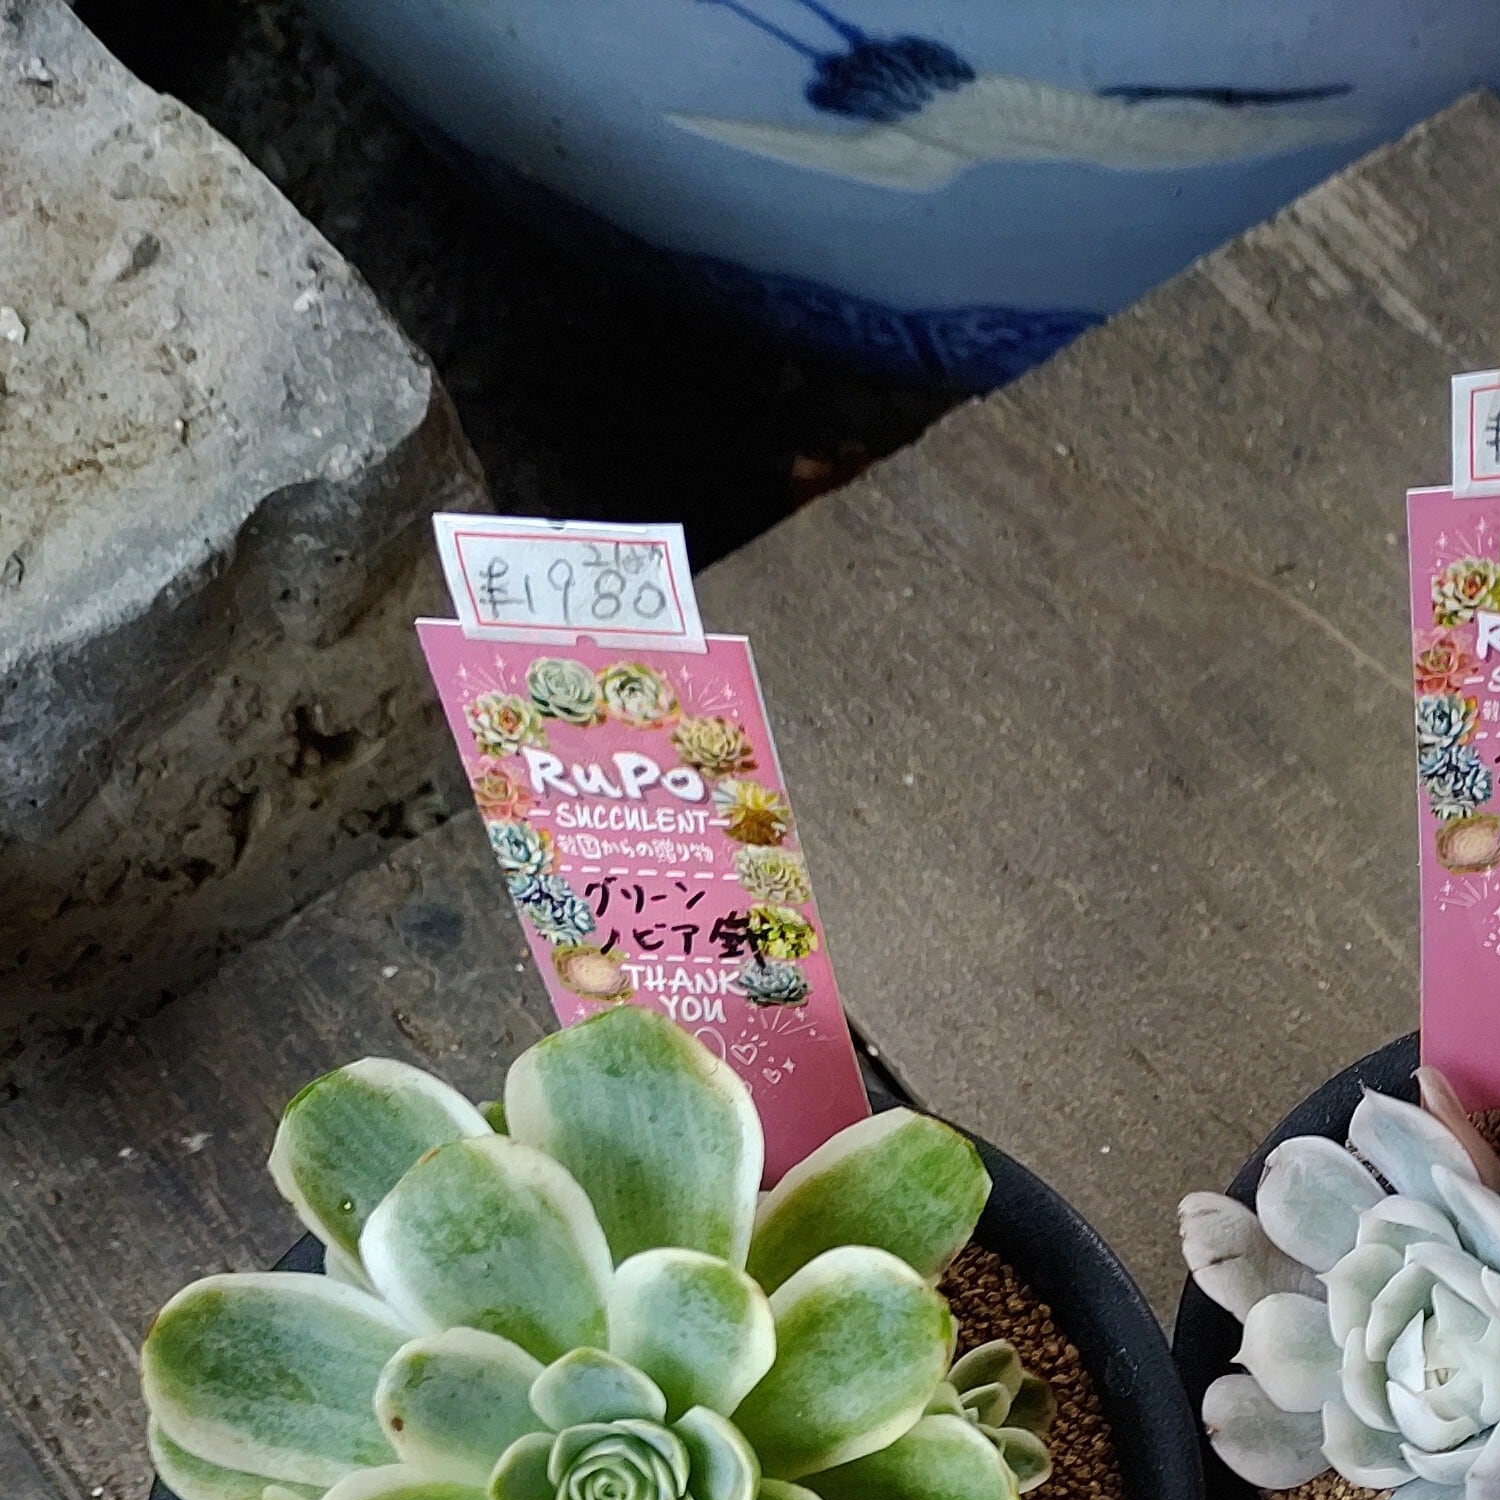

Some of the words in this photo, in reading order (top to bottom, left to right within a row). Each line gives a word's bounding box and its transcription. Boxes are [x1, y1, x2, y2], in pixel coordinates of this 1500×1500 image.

[523, 745, 707, 800] RuPo
[556, 803, 709, 834] SUCCULENT
[584, 877, 706, 917] グリーン
[622, 964, 749, 997] THANK
[659, 996, 727, 1023] YOU
